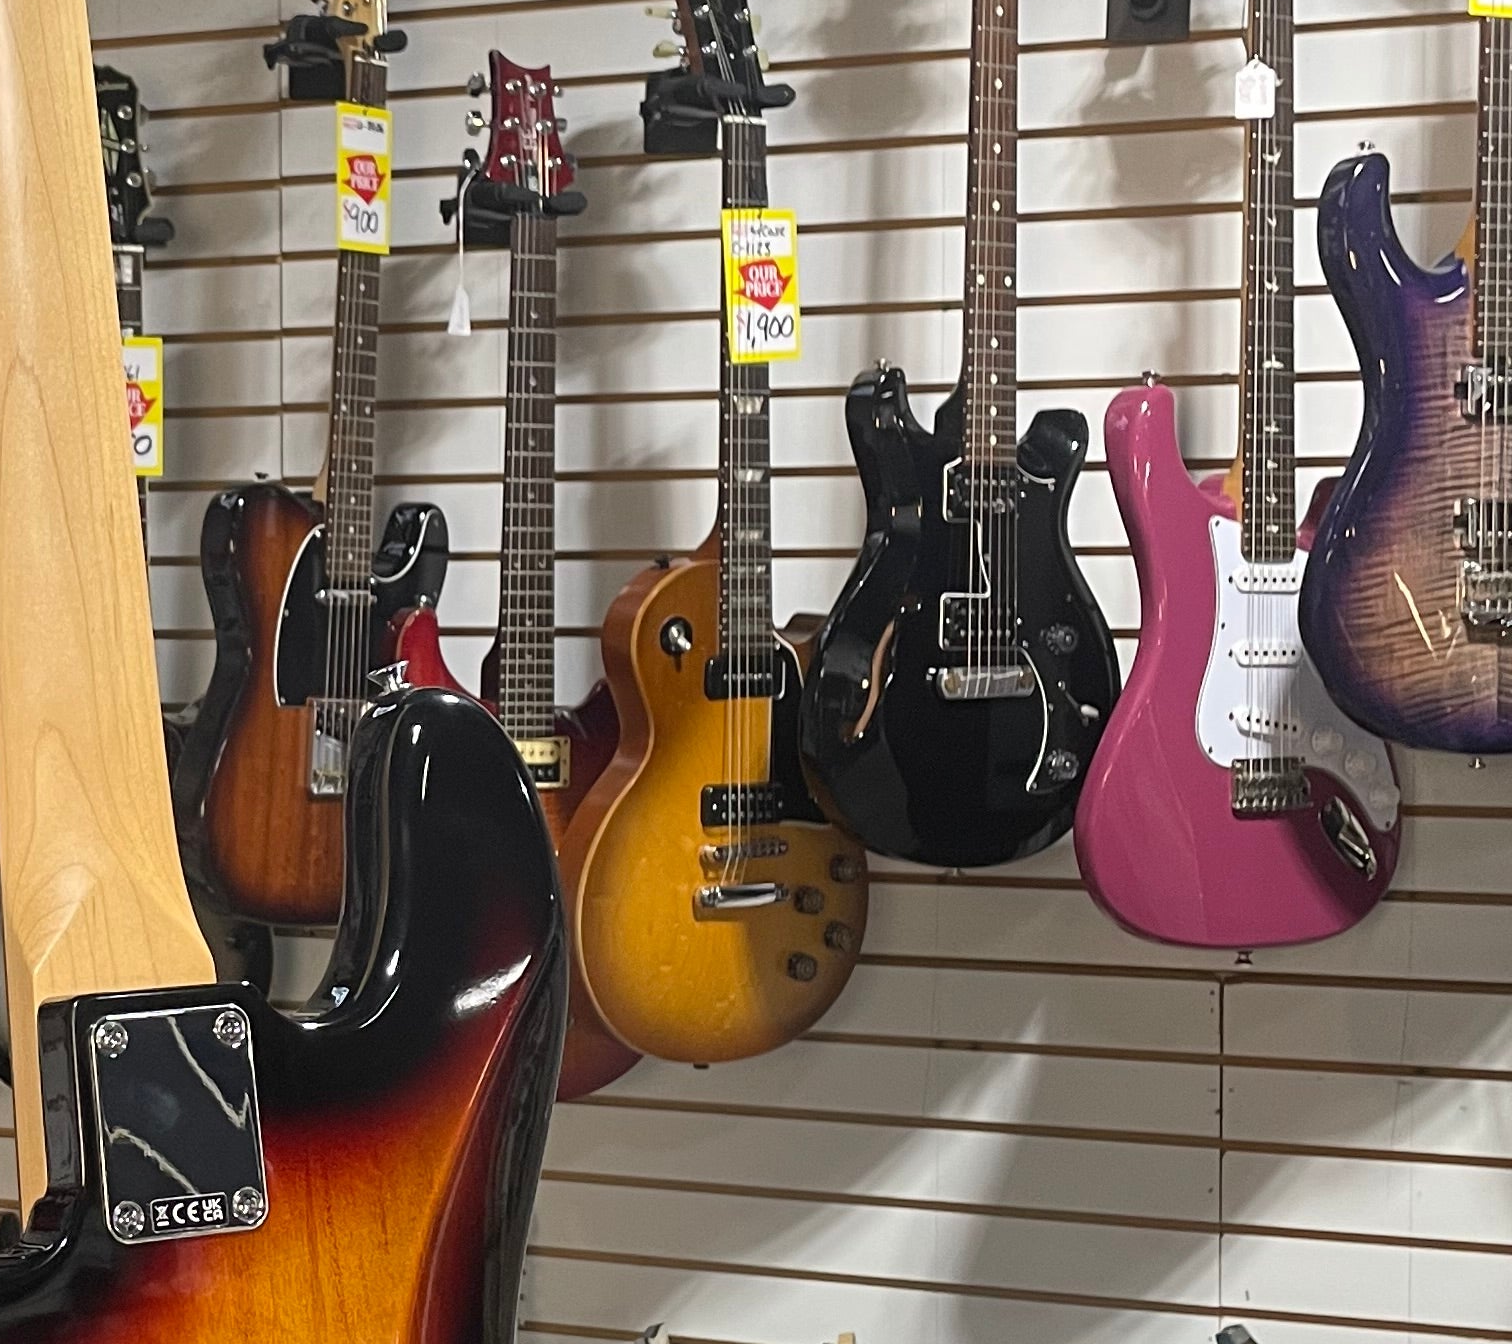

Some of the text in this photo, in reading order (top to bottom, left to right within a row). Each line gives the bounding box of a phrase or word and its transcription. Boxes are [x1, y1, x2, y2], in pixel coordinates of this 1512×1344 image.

[748, 264, 778, 281] OUR
[746, 279, 783, 298] PRICE
[172, 1201, 199, 1224] CE
